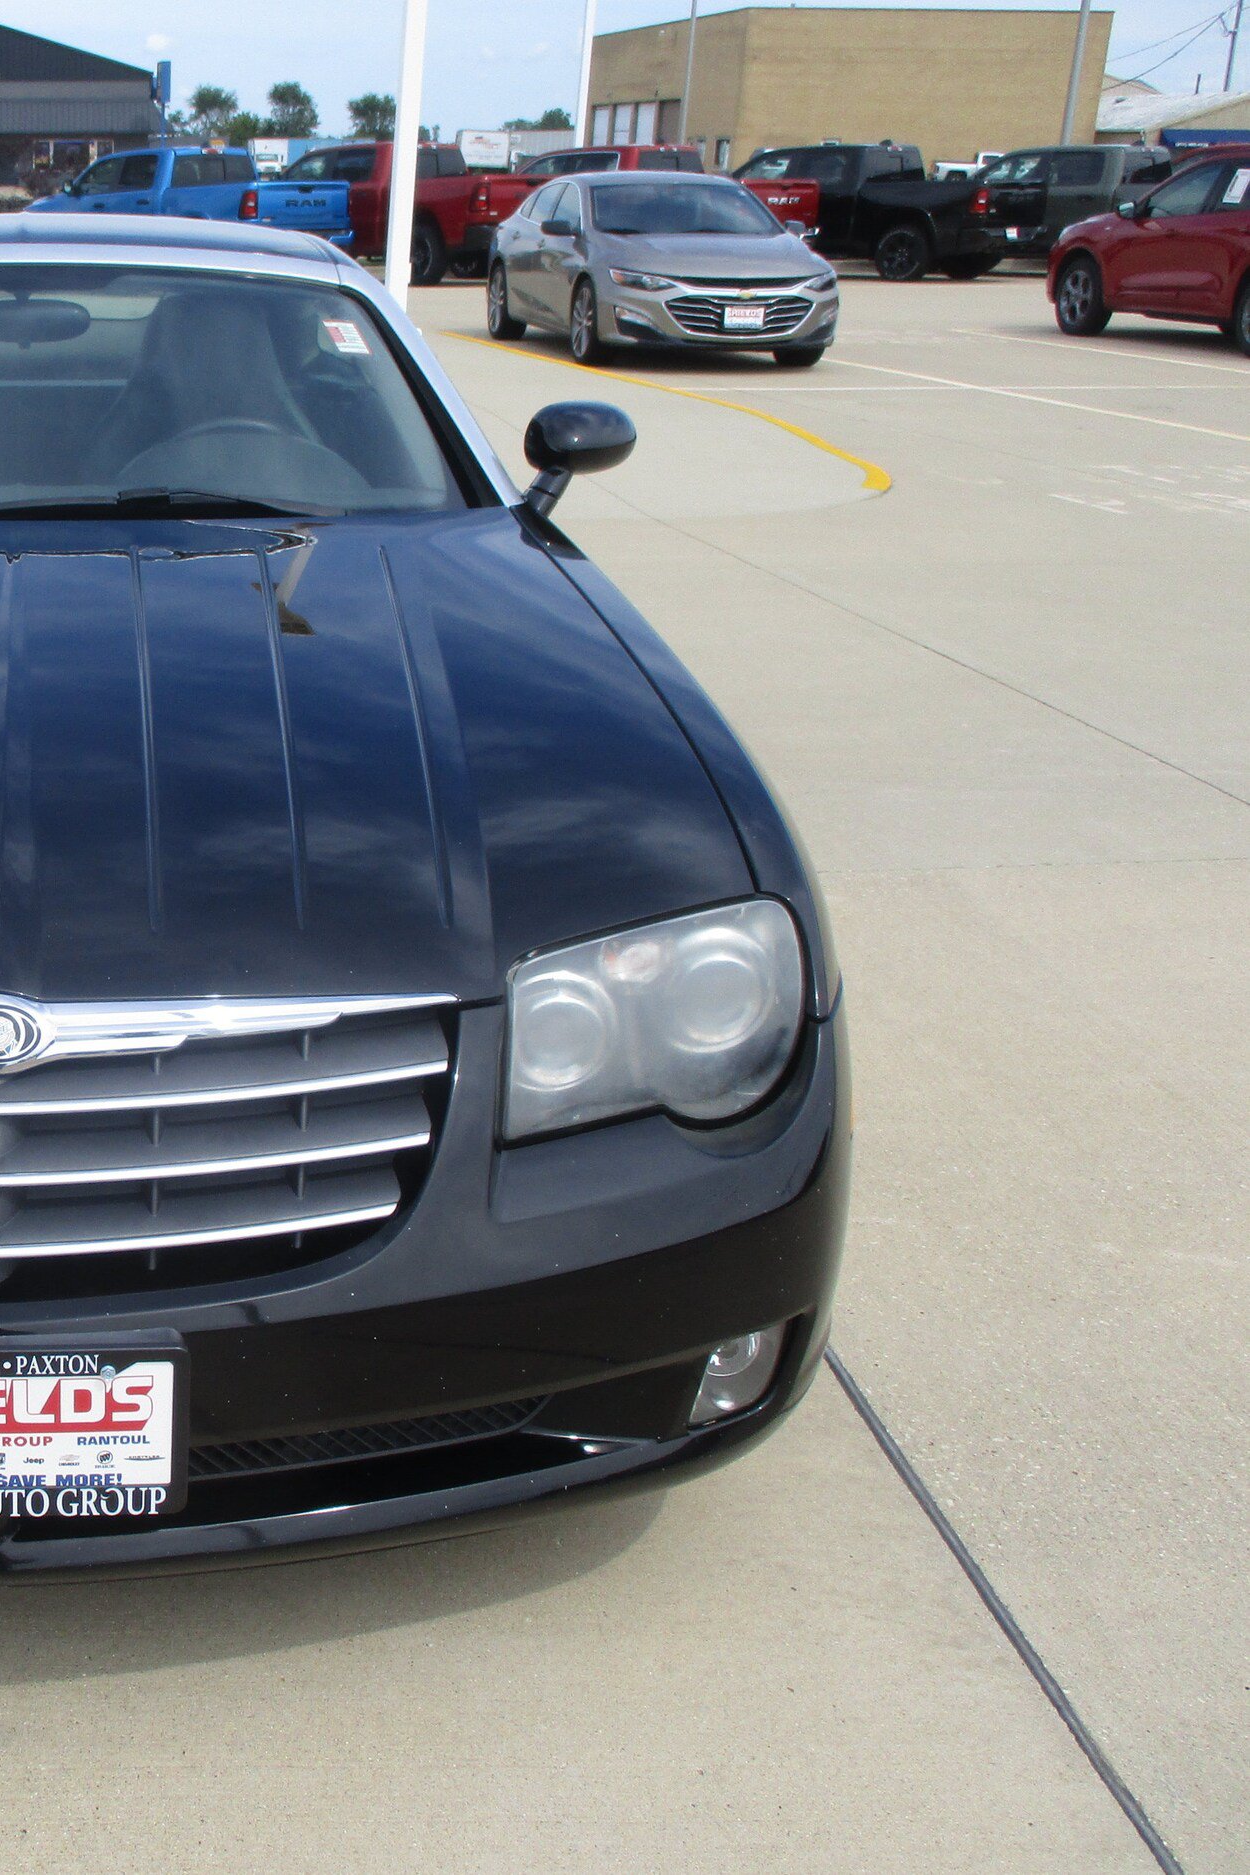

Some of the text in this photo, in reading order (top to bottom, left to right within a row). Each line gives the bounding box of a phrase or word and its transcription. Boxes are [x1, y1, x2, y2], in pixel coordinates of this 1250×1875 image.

[285, 199, 326, 208] RAM
[15, 1354, 100, 1376] PAXTON
[77, 1435, 151, 1446] RANTOUL
[23, 1457, 45, 1465] Jeep
[55, 1473, 123, 1487] MORE!
[56, 1486, 168, 1517] GROUP
